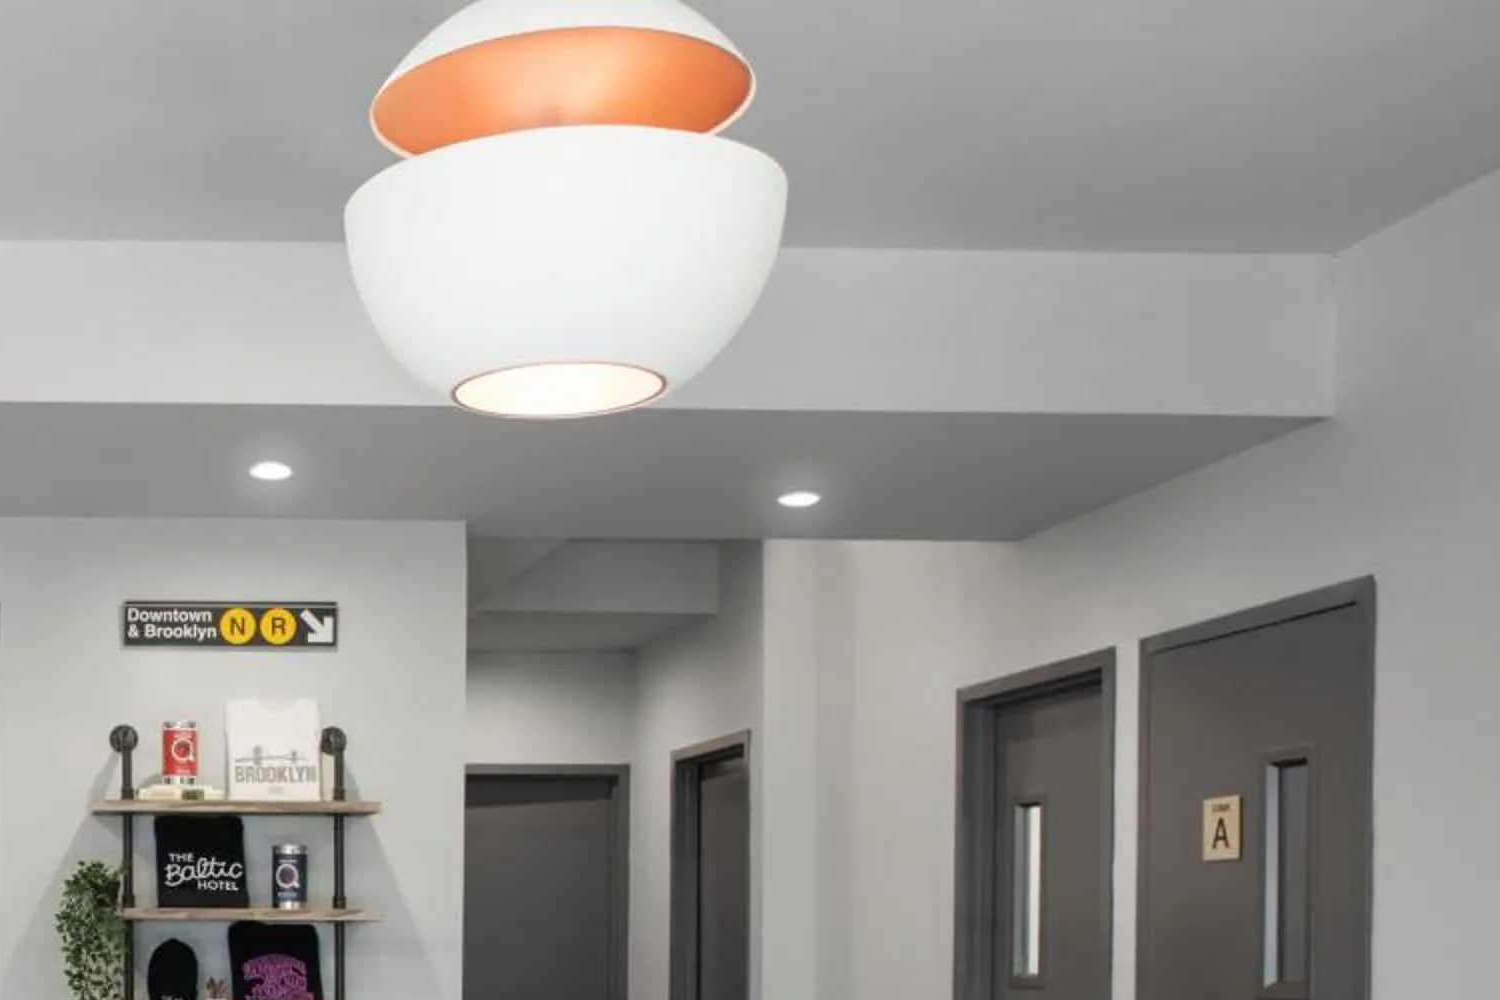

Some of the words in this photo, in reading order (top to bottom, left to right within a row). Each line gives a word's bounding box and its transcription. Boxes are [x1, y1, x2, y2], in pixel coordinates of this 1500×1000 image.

[127, 608, 213, 623] Downtown
[127, 624, 140, 638] &
[144, 623, 218, 641] Brooklyn
[230, 617, 246, 636] N
[271, 617, 287, 635] R
[235, 765, 317, 784] BROOKLYN
[1212, 817, 1230, 849] A
[168, 852, 195, 862] THE
[164, 857, 243, 887] Baltic
[197, 880, 240, 891] HOTEL
